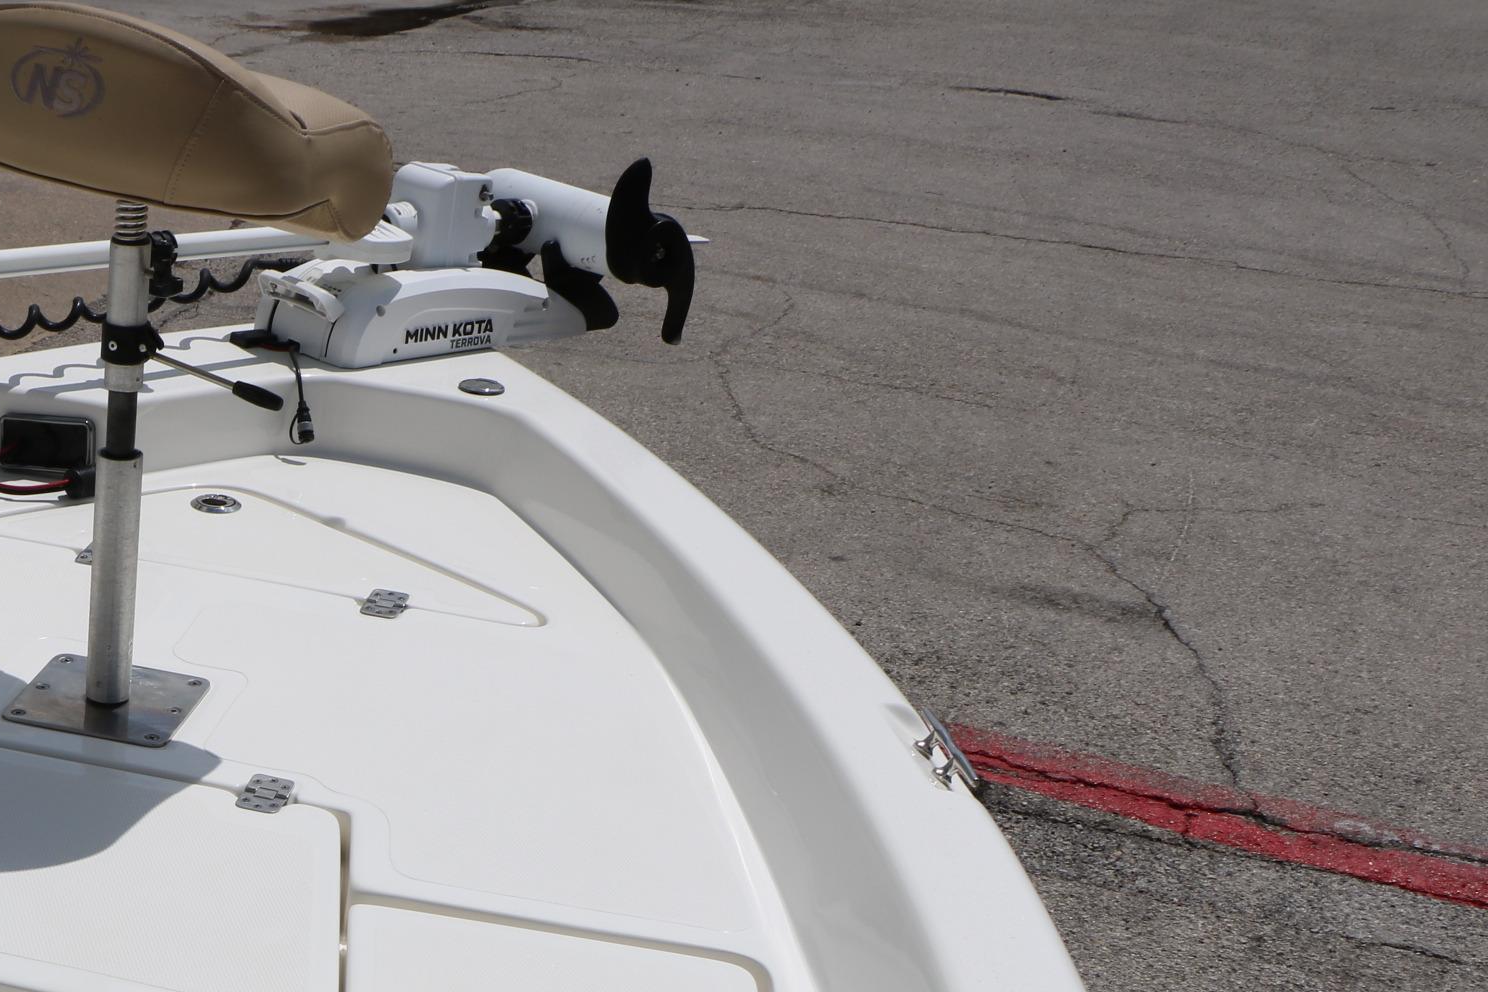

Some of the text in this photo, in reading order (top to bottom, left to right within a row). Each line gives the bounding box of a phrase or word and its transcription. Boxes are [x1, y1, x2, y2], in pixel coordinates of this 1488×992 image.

[404, 318, 494, 344] MINN KOTA
[450, 334, 491, 349] TERROVA
